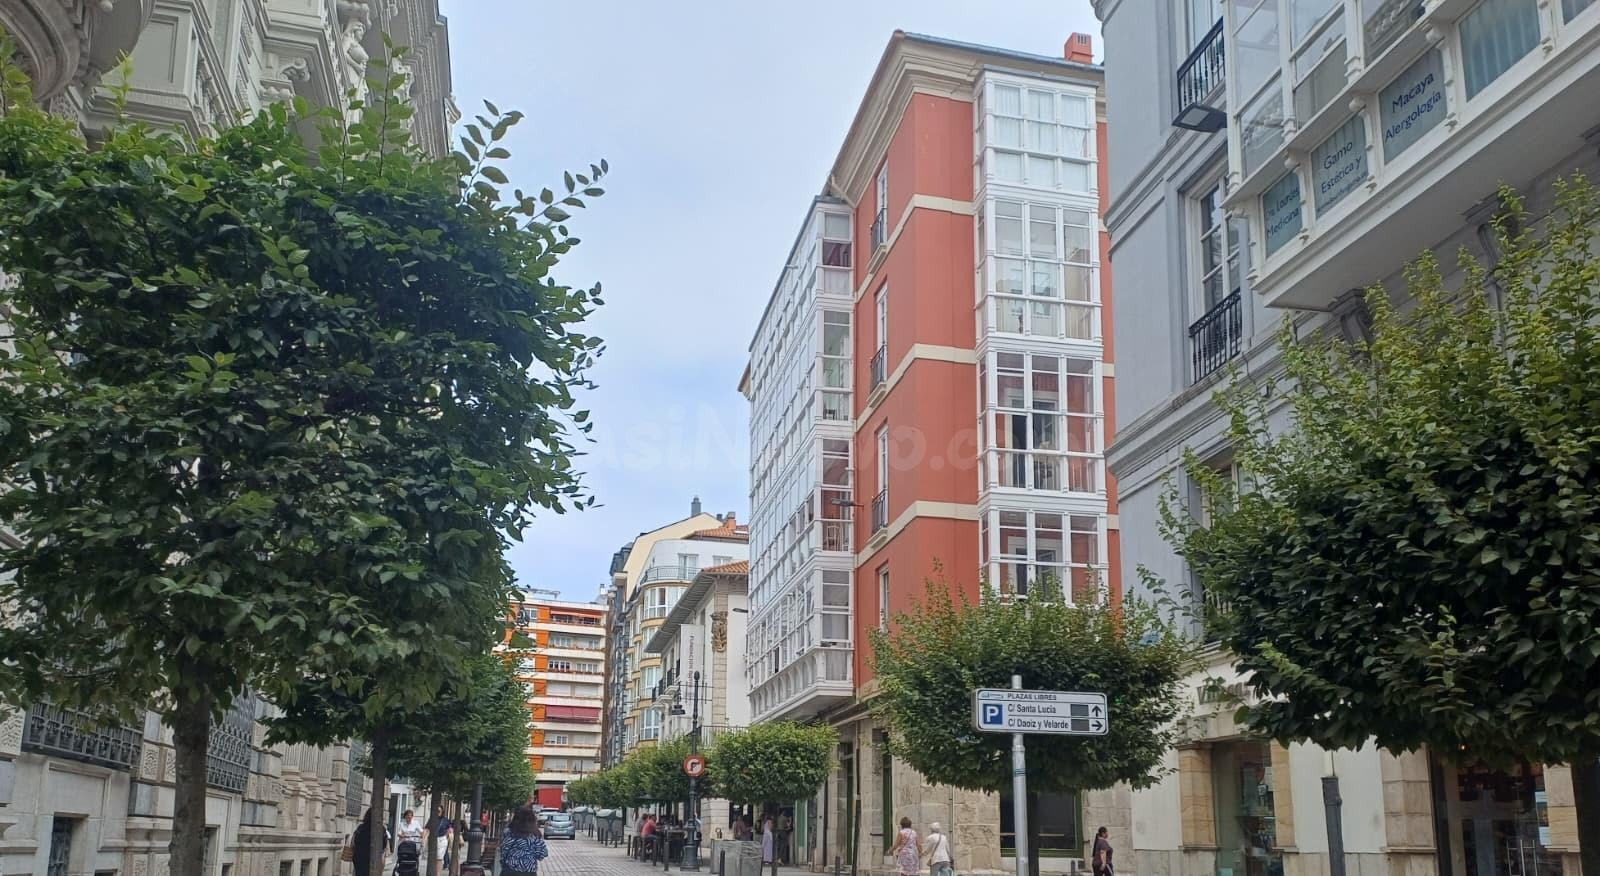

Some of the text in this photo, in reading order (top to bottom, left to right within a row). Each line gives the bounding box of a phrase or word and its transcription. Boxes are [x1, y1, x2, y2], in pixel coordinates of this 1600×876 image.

[1392, 73, 1434, 113] Macaya
[1324, 142, 1353, 169] Gamo
[1321, 162, 1354, 194] Estética
[1266, 207, 1299, 238] Medicina
[1008, 692, 1033, 700] PLAZAS
[986, 705, 999, 722] P
[1008, 703, 1015, 712] C/
[1017, 704, 1037, 713] Santa
[1008, 719, 1015, 727] C/
[1017, 720, 1036, 728] Daoiz
[1044, 720, 1069, 729] Velarde
